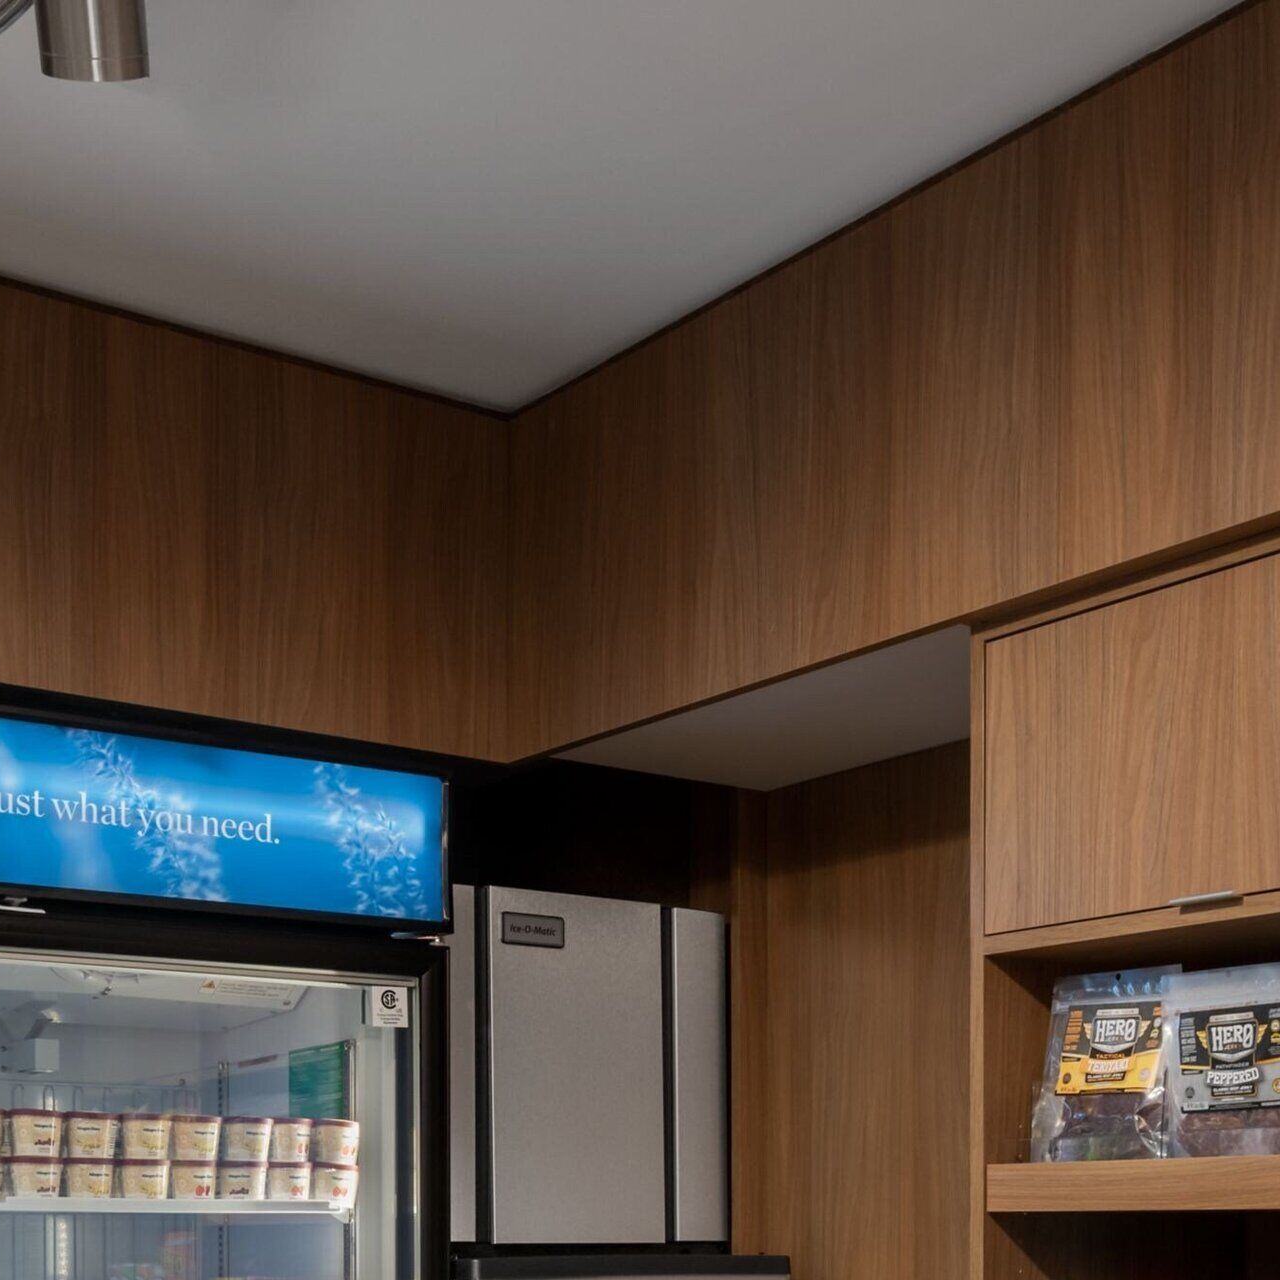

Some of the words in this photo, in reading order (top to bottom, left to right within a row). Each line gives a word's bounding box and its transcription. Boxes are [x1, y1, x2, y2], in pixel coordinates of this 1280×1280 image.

[51, 791, 131, 828] what
[135, 808, 194, 837] you
[201, 814, 281, 845] need.
[1206, 1068, 1260, 1085] PEPPERED
